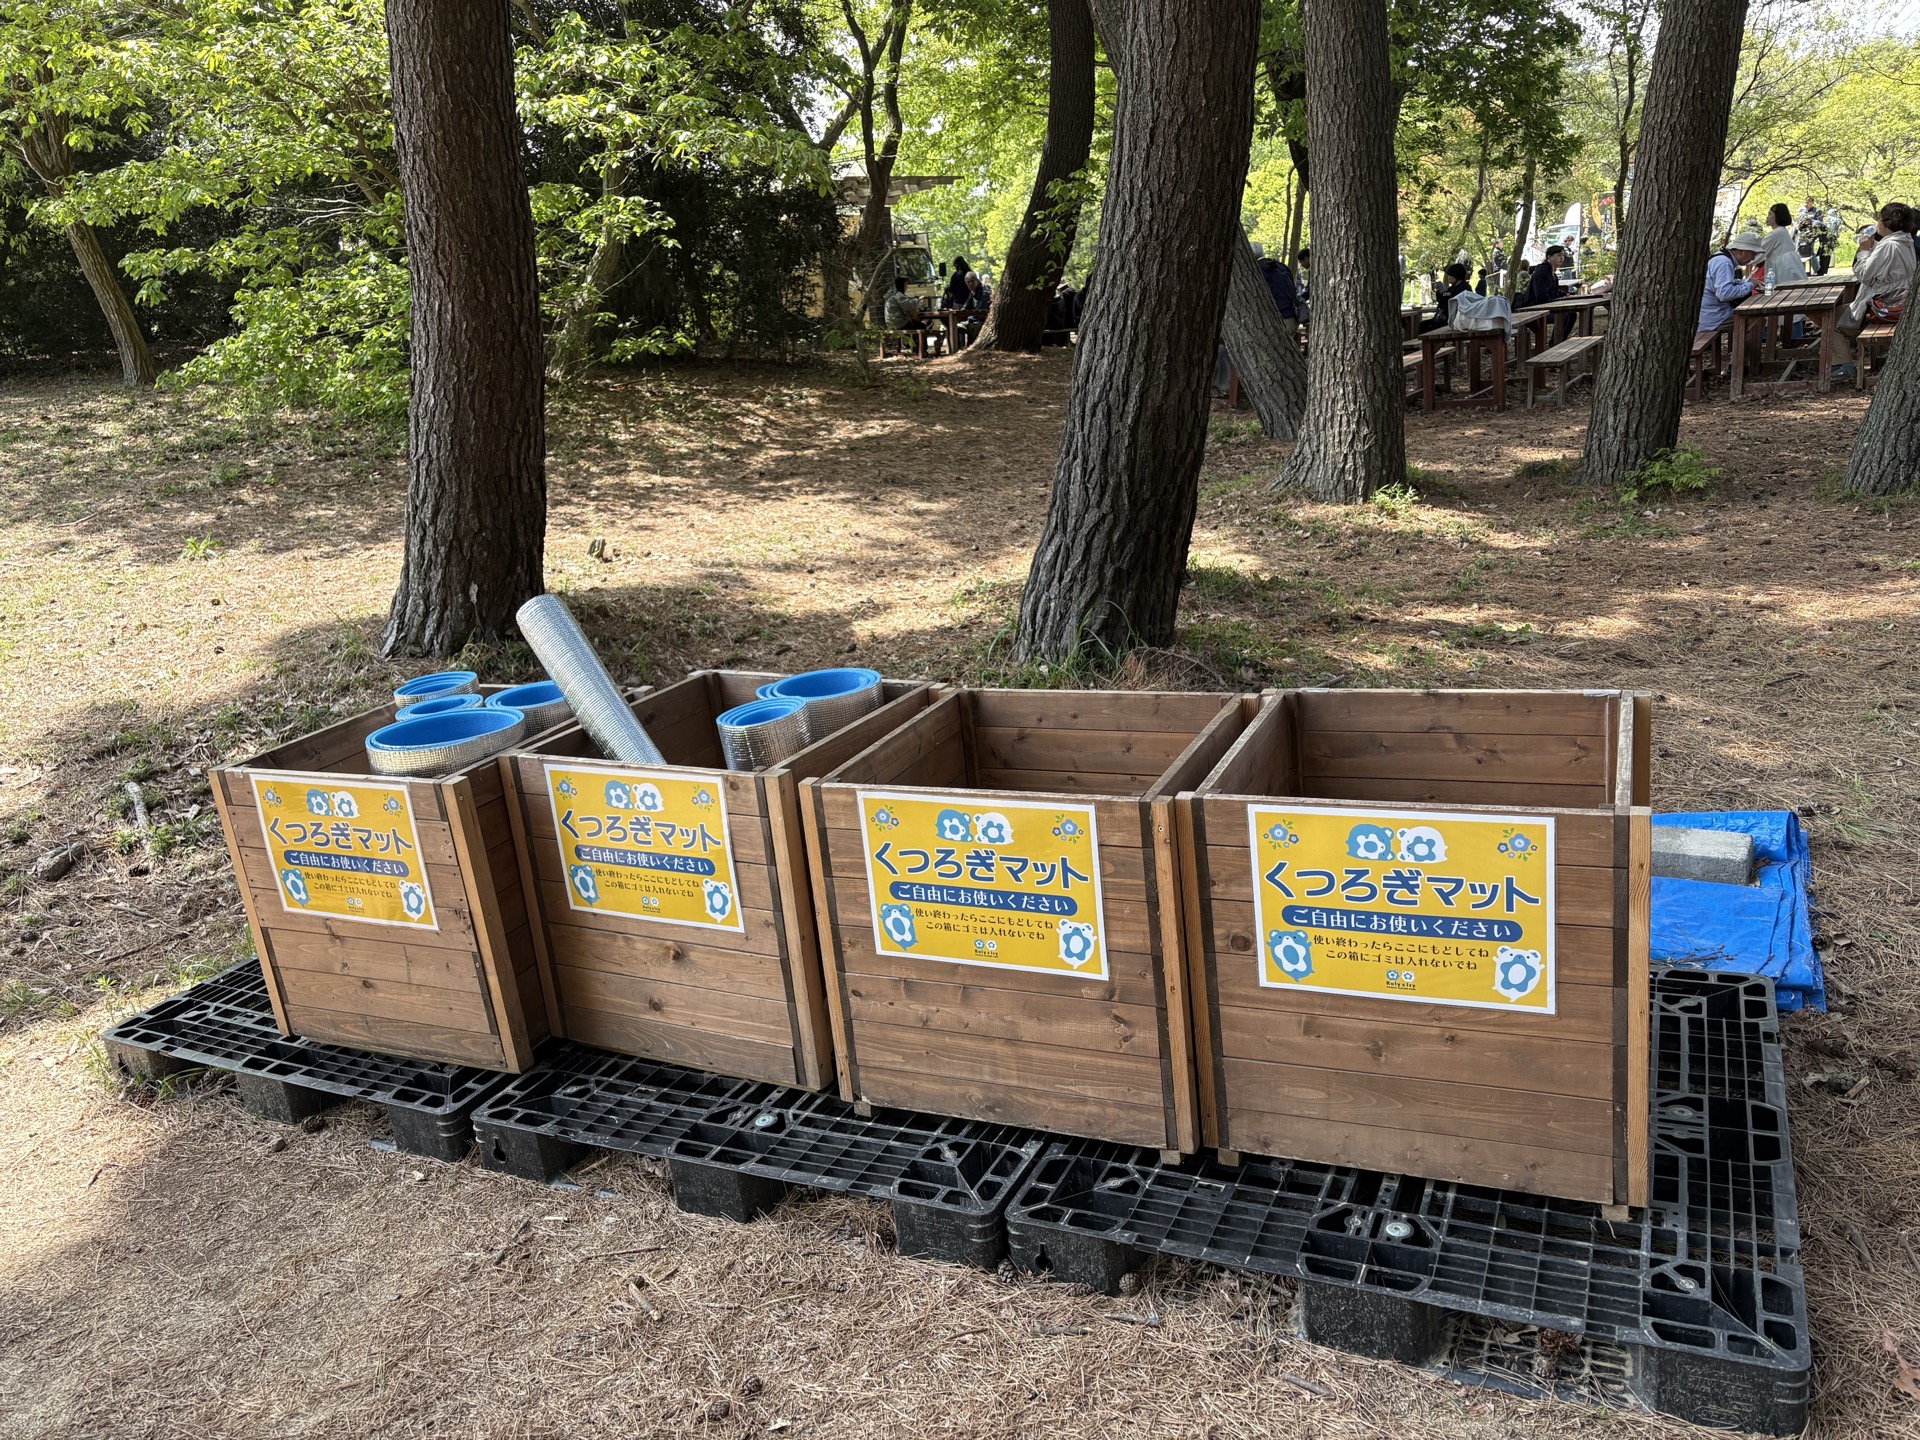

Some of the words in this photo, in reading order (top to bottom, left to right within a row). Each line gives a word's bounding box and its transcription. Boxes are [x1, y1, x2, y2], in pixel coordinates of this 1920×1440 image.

[269, 817, 413, 855] くつろぎマット
[561, 810, 722, 852] くつろぎマット
[290, 852, 404, 874] ご自由にお使いください
[581, 847, 709, 872] ご自由にお使いください
[874, 842, 1089, 889] くつろぎマット
[898, 884, 1069, 912] ご自由にお使いください
[1265, 861, 1540, 913] くつろぎマット
[915, 907, 1054, 930] 使い終わったらここにもどしてね
[926, 921, 1045, 941] この箱にゴミは入れないでね
[1293, 908, 1511, 938] ご自由にお使いください
[1313, 934, 1489, 959] 使い終わったらここにもどしてね
[1326, 950, 1477, 971] この箱にゴミは入れないでね
